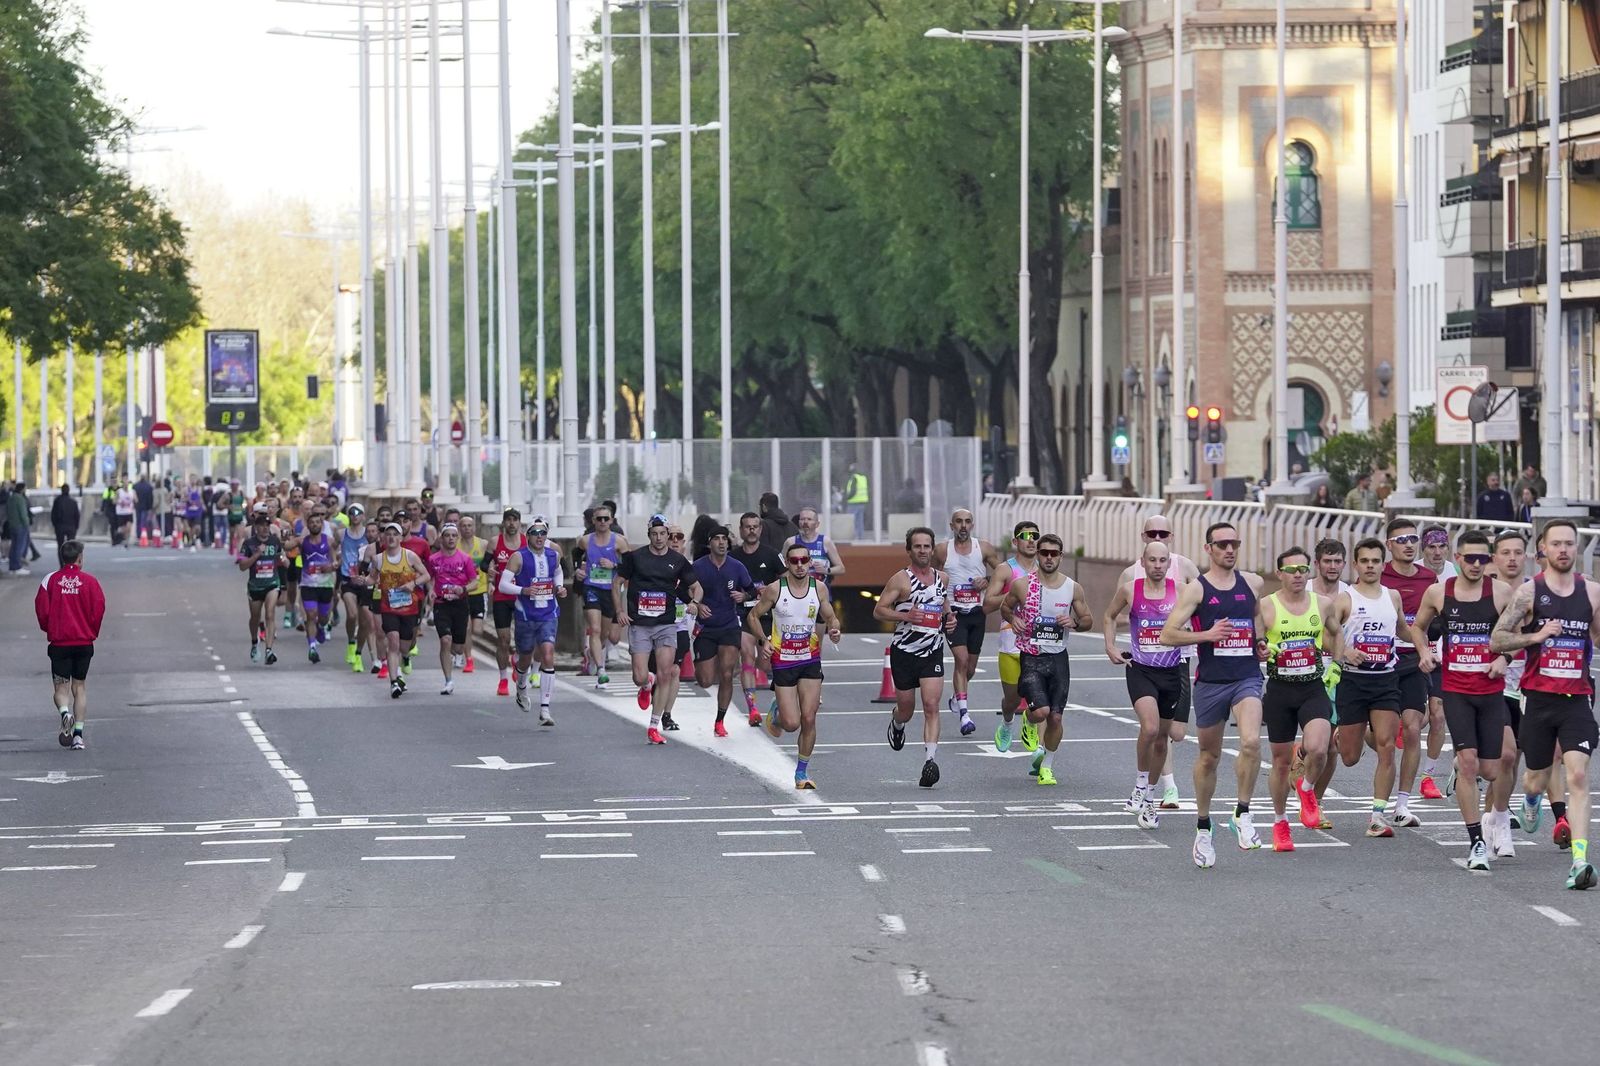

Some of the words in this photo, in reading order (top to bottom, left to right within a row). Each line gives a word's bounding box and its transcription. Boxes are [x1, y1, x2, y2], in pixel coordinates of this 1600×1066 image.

[1466, 622, 1490, 630] TOURS
[1219, 639, 1249, 647] FLORIAN
[1366, 653, 1387, 662] STIEN
[1456, 654, 1482, 663] KEVAN
[1286, 658, 1308, 667] DAVID
[1548, 659, 1575, 668] DYLAN
